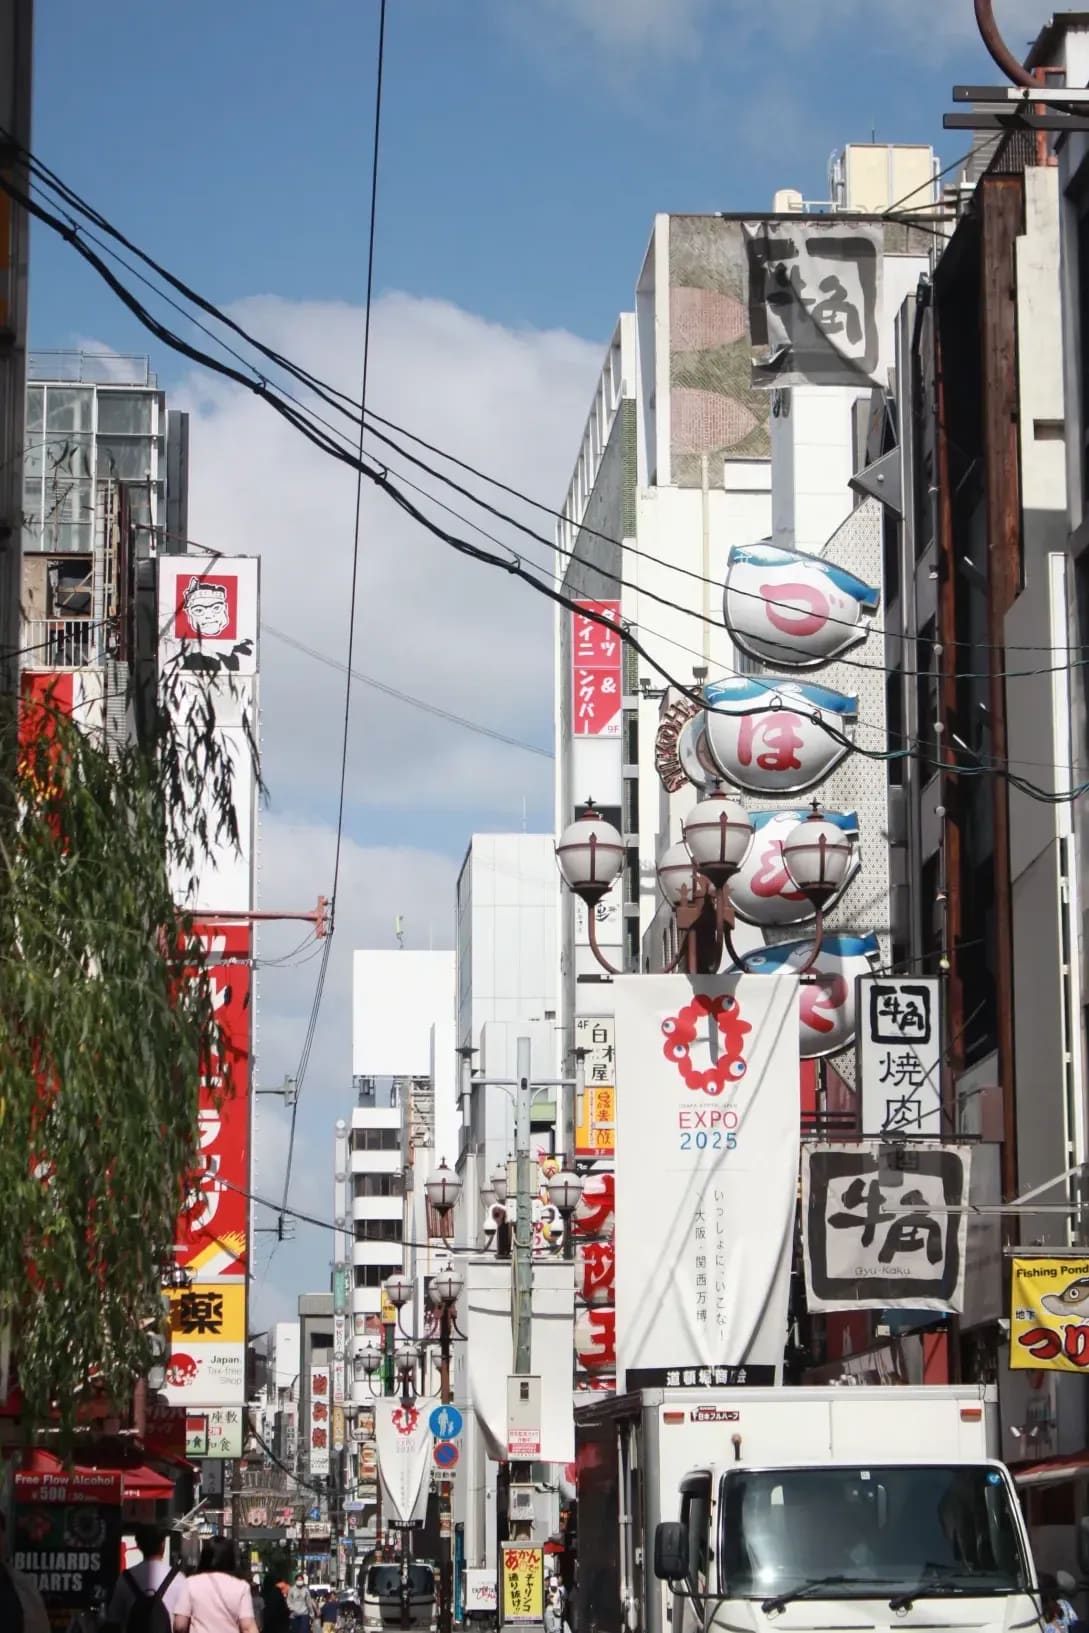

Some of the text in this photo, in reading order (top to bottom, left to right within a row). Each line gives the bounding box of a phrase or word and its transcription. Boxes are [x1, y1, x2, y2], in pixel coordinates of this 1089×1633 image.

[879, 996, 924, 1031] 牛角
[577, 1020, 589, 1030] 4F
[879, 1052, 923, 1130] 焼肉
[679, 1111, 738, 1129] EXPO
[680, 1132, 737, 1150] 2025
[827, 1178, 943, 1265] 牛角
[1016, 1267, 1057, 1278] Fishing
[181, 1292, 223, 1334] 薬
[211, 1356, 240, 1365] Japan
[15, 1474, 114, 1485] Free Flow Alcohol
[14, 1552, 101, 1570] BILLIARDS
